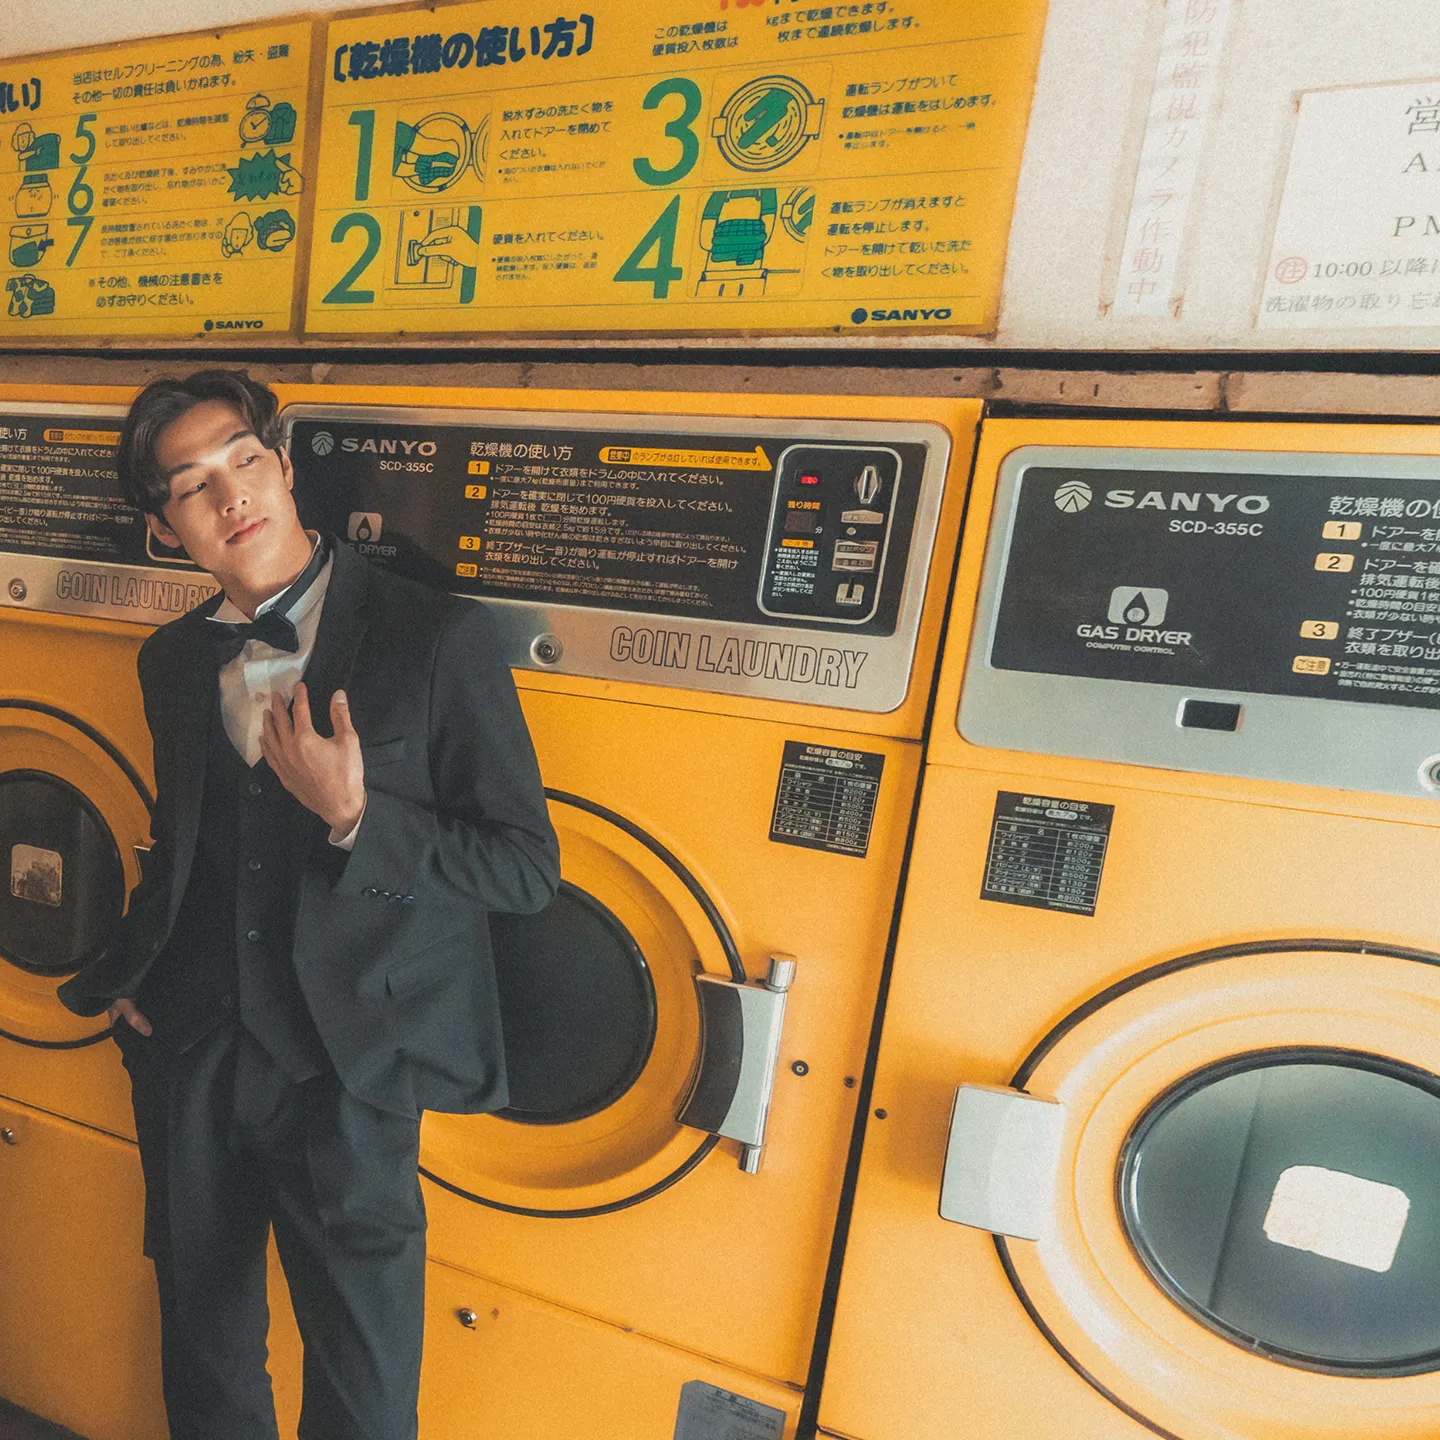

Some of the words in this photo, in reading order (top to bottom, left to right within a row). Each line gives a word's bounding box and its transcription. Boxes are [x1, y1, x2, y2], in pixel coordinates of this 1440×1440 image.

[654, 20, 728, 39] この乾燥機は
[652, 35, 739, 57] 硬貨投入枚数は
[845, 74, 958, 96] 運転ランプがついて
[502, 100, 614, 123] 脱水ずみの洗たく物を
[842, 94, 997, 118] 乾燥機は運転をはじめます。
[69, 113, 97, 166] 5
[500, 121, 611, 141] 入れてドアーを閉めて
[633, 77, 702, 186] 3
[348, 109, 375, 200] 1
[499, 147, 547, 161] ください。
[67, 166, 94, 216] 6
[829, 194, 966, 215] 運転ランプが消えますと
[493, 229, 605, 245] 硬貨を入れてください。
[827, 220, 930, 236] 運転を停止します。
[66, 215, 95, 268] 7
[613, 194, 682, 299] 4
[823, 240, 972, 257] ドアーを開けて乾いた洗た
[321, 212, 381, 304] 2
[821, 263, 969, 278] く物を取り出してください。
[1314, 261, 1372, 279] 10:00
[96, 293, 195, 308] 必ずお守りください。
[871, 309, 952, 321] SANYO
[216, 320, 264, 330] SANYO
[341, 438, 437, 456] SANYO
[470, 442, 574, 461] 乾燥機の使い方
[379, 460, 434, 473] SCD-355C
[494, 463, 724, 486] ドアーを開けて衣類をドラムの中に入れてください。
[492, 488, 732, 513] ドアーを確実に閉じて100円硬貨を投入してください。
[787, 501, 821, 510] 残り時間
[1105, 490, 1270, 515] SANYO
[814, 526, 822, 534] 分
[1169, 520, 1263, 536] SCD-355C
[359, 544, 397, 556] DRYER
[485, 552, 600, 569] 衣類を取り出してください。
[56, 571, 107, 604] COIN
[110, 576, 216, 613] LAUNDRY
[1355, 599, 1440, 612] 乾燥時間の目安
[1077, 624, 1118, 640] GAS
[1125, 626, 1191, 646] DRYER
[610, 626, 691, 669] COIN
[696, 635, 867, 688] LAUNDRY
[1085, 642, 1131, 652] COMPUTER
[1133, 645, 1175, 656] CONTROL
[1296, 658, 1327, 672] ご注意
